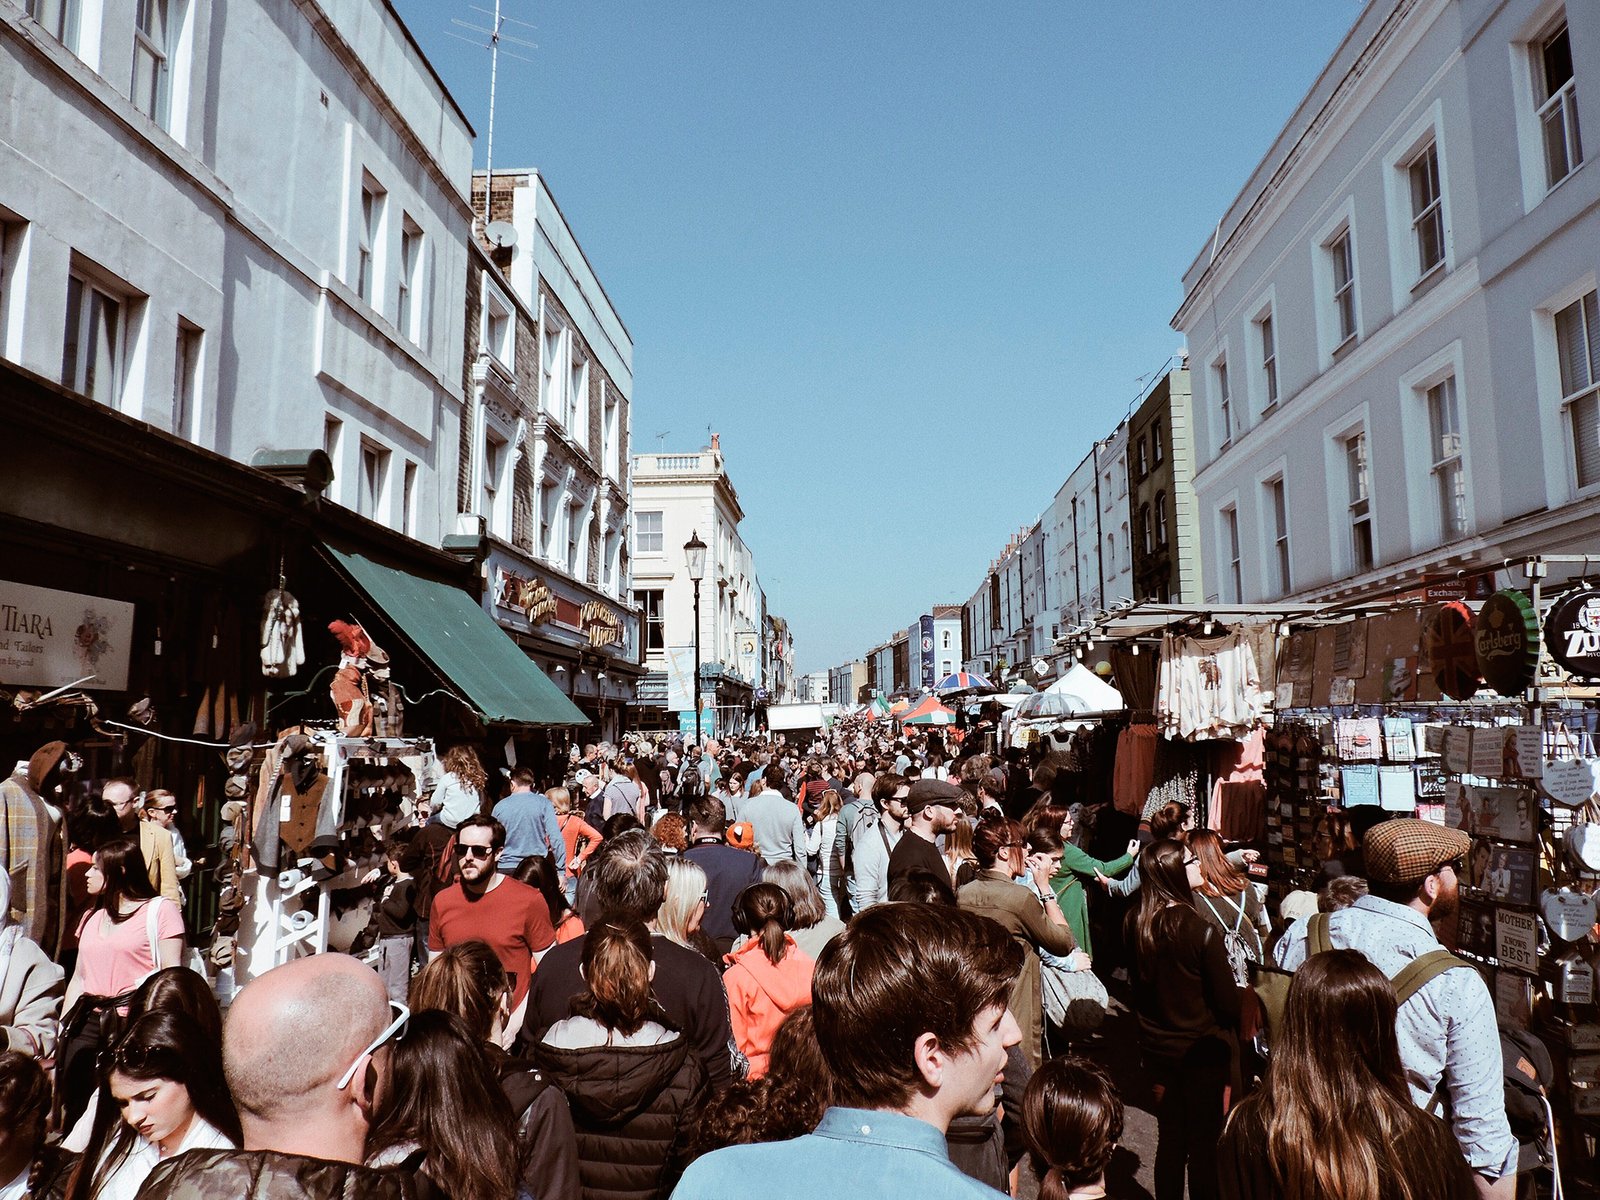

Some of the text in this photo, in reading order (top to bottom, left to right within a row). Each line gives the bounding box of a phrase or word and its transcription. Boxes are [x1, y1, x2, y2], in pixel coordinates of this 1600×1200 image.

[1427, 589, 1468, 597] Exchange
[1, 604, 53, 639] TIARA
[14, 640, 44, 653] Tailors
[1475, 629, 1521, 658] Carlsberg
[1498, 911, 1533, 931] MOTHER
[1504, 936, 1527, 950] KNOWS
[1501, 944, 1530, 964] BEST
